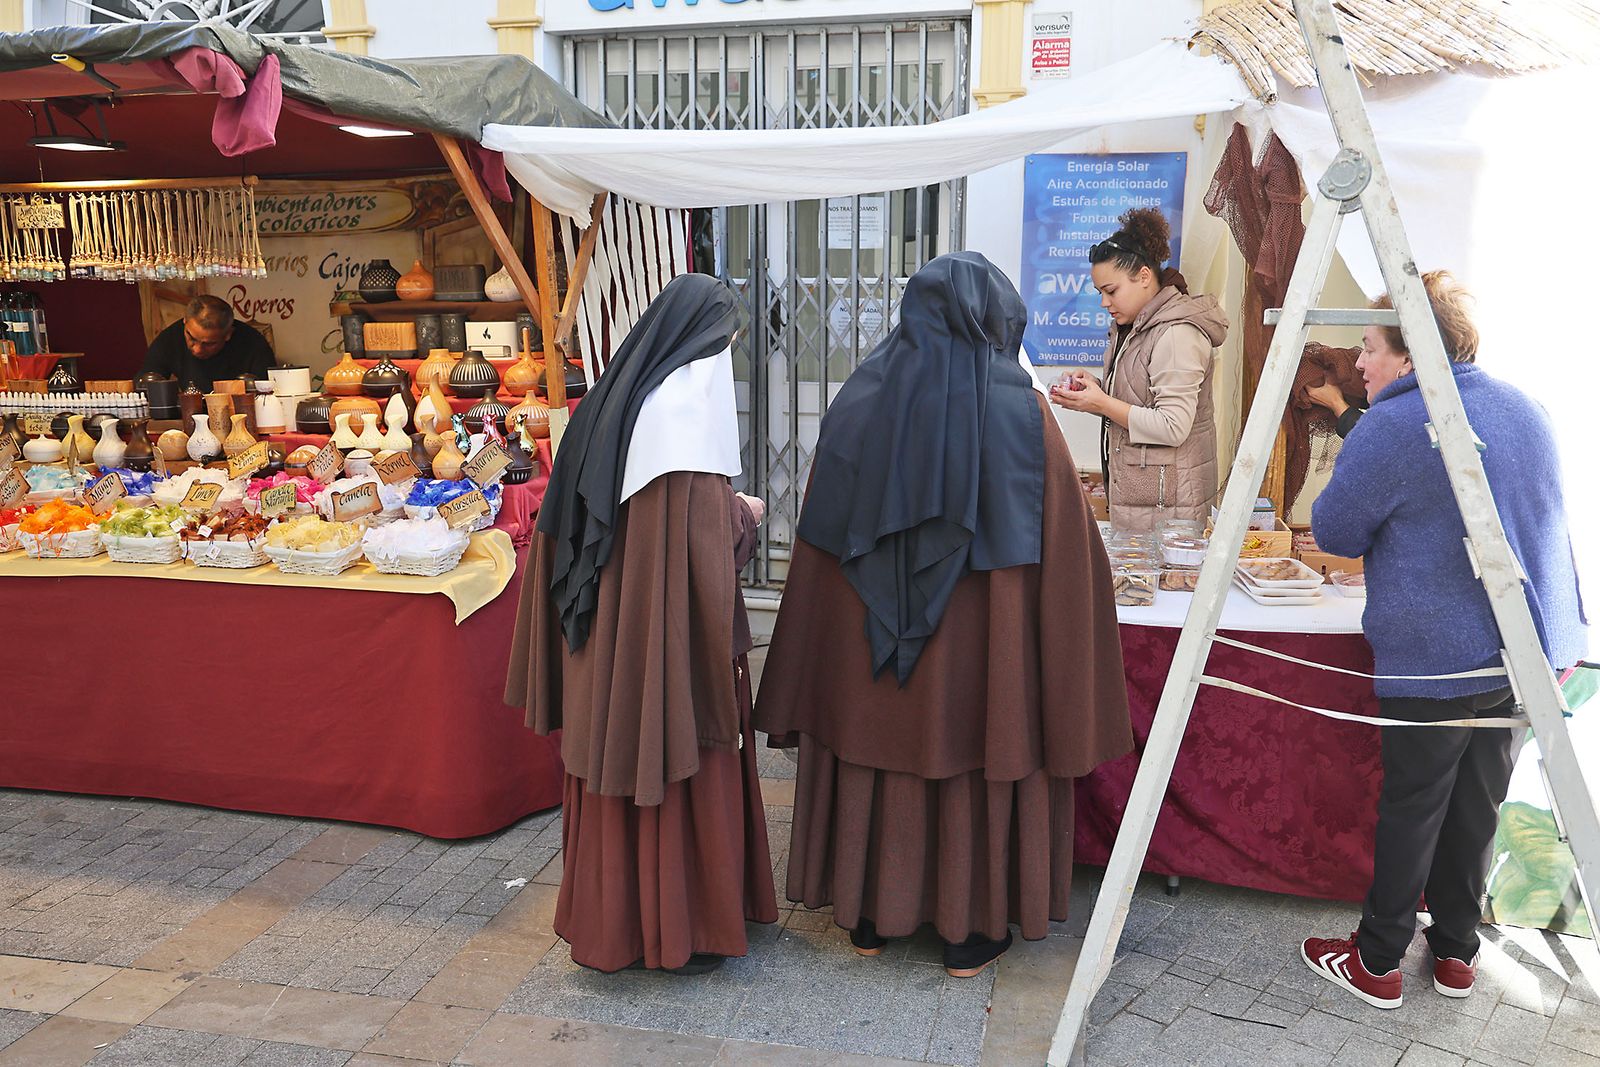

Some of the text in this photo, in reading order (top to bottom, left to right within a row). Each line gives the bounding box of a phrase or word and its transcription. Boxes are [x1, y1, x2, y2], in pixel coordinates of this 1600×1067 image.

[1034, 23, 1070, 31] verisure
[1034, 40, 1069, 49] Alarma
[1067, 160, 1150, 174] Energía Solar
[1047, 178, 1168, 189] Aire Acondicionado
[1052, 195, 1161, 206] Estufas de Pellets
[1073, 212, 1120, 224] Fontan
[1059, 230, 1113, 241] Instalaci
[265, 252, 366, 290] arios Cajo
[1033, 311, 1053, 325] M.
[1058, 312, 1090, 326] 665
[1047, 337, 1111, 347] www.awas
[1038, 352, 1104, 363] awasun@ou
[467, 446, 498, 479] Marino
[89, 475, 115, 506] Mango
[339, 485, 372, 506] Canela
